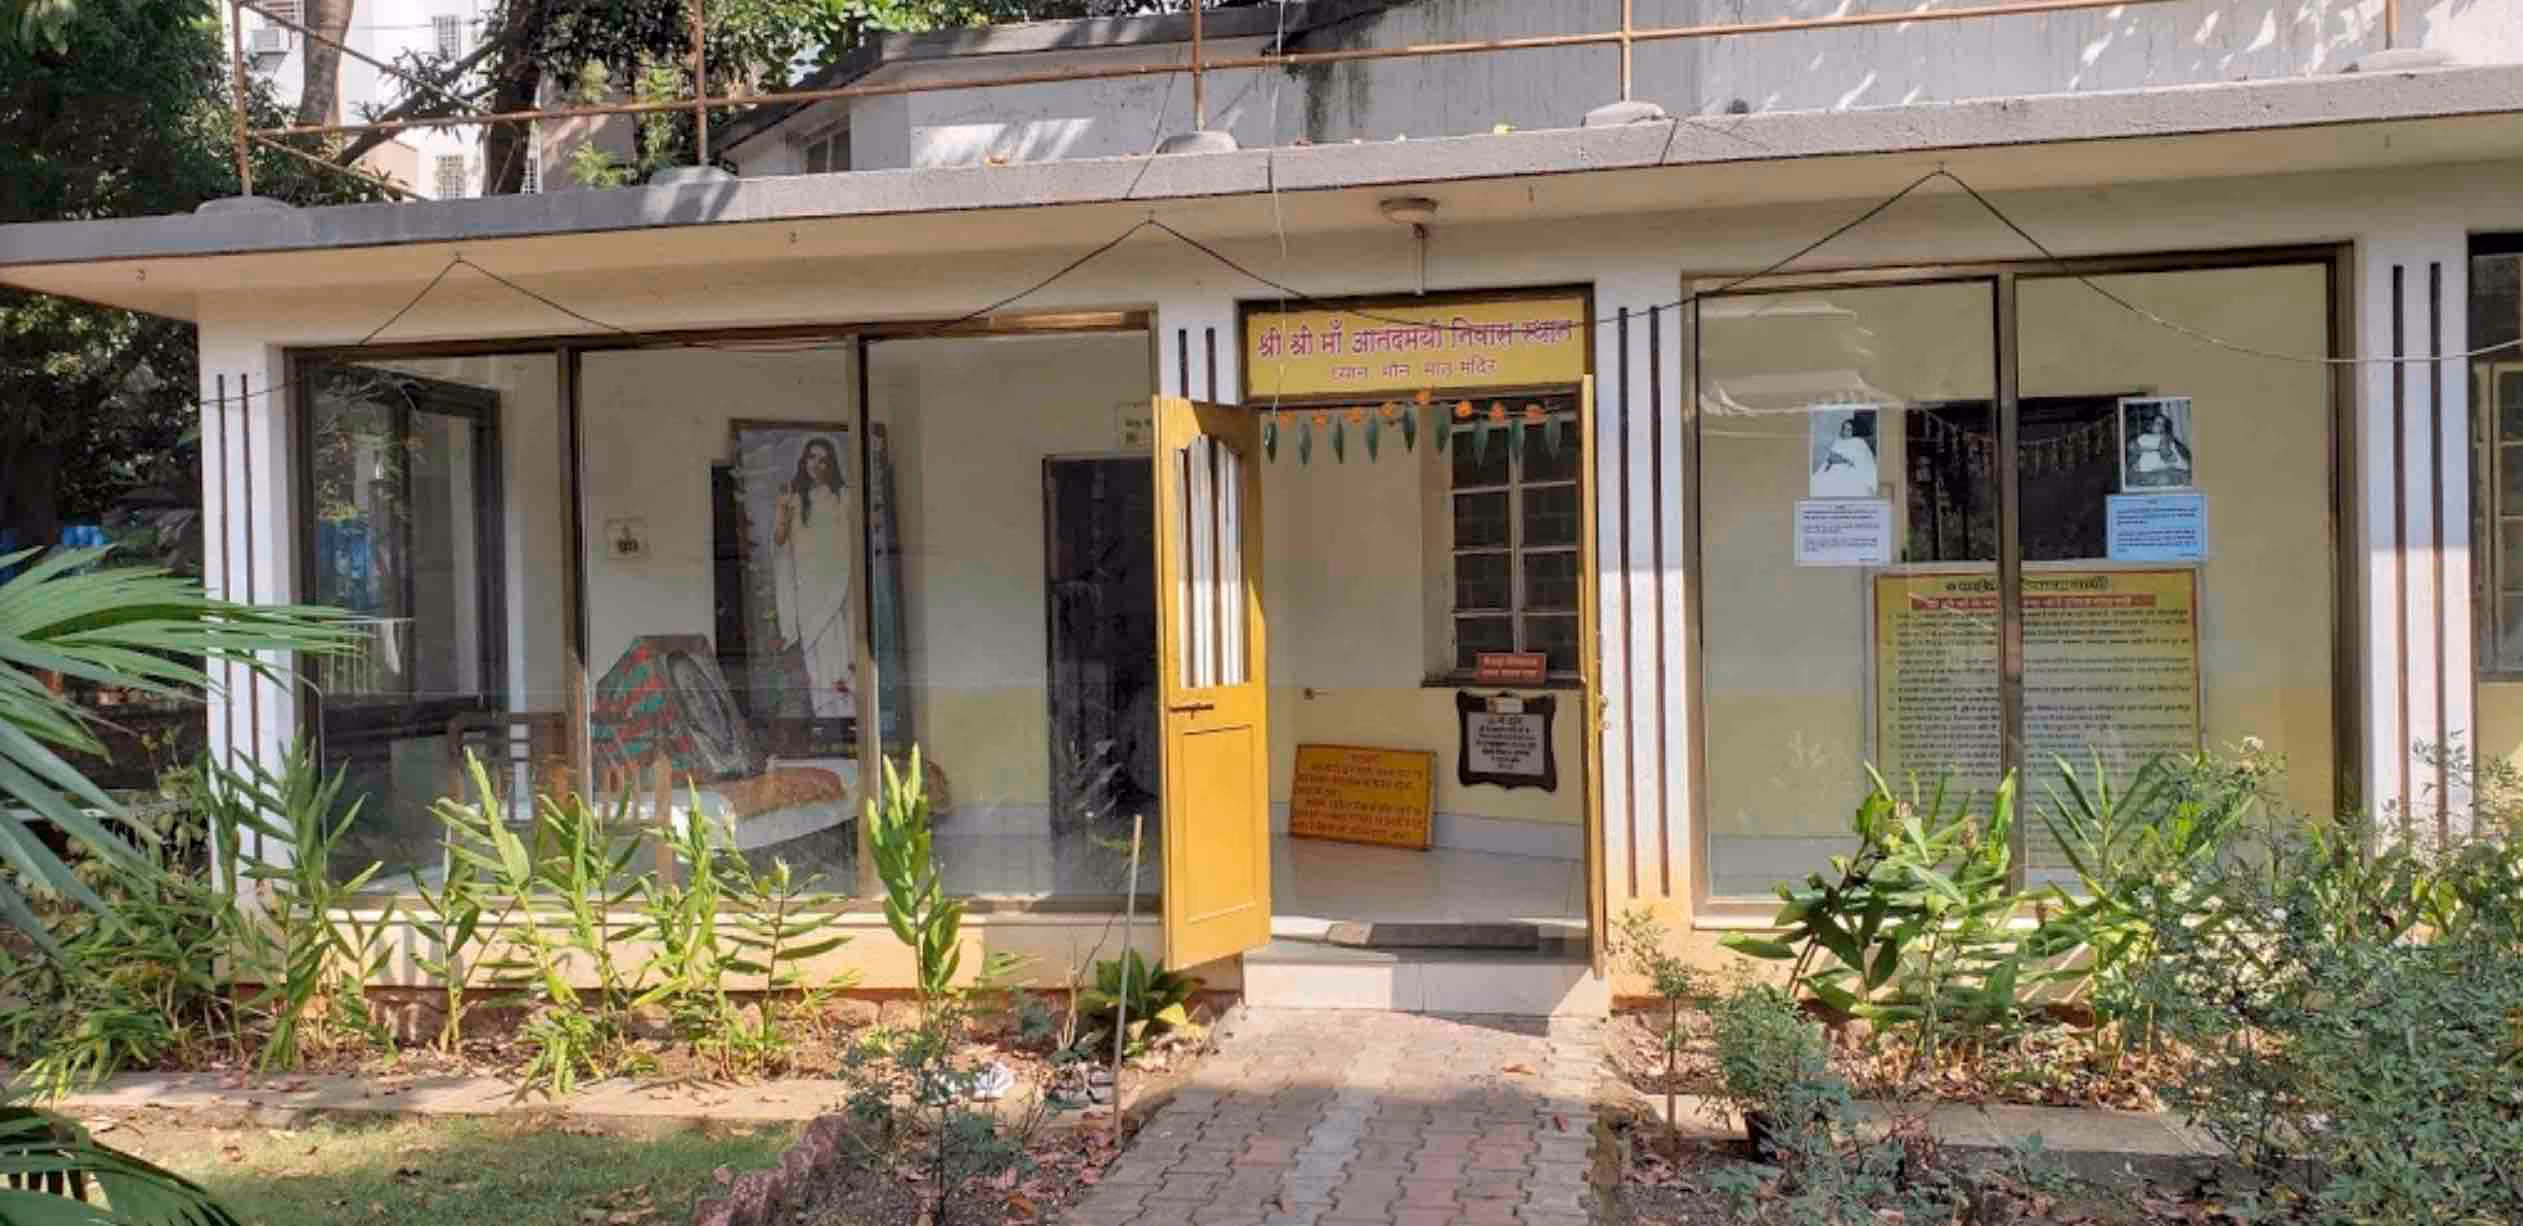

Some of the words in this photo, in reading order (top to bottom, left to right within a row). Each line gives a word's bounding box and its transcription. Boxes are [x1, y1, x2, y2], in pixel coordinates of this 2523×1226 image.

[1258, 326, 1281, 357] श्री
[1289, 323, 1312, 356] श्री
[1452, 317, 1513, 348] निवास
